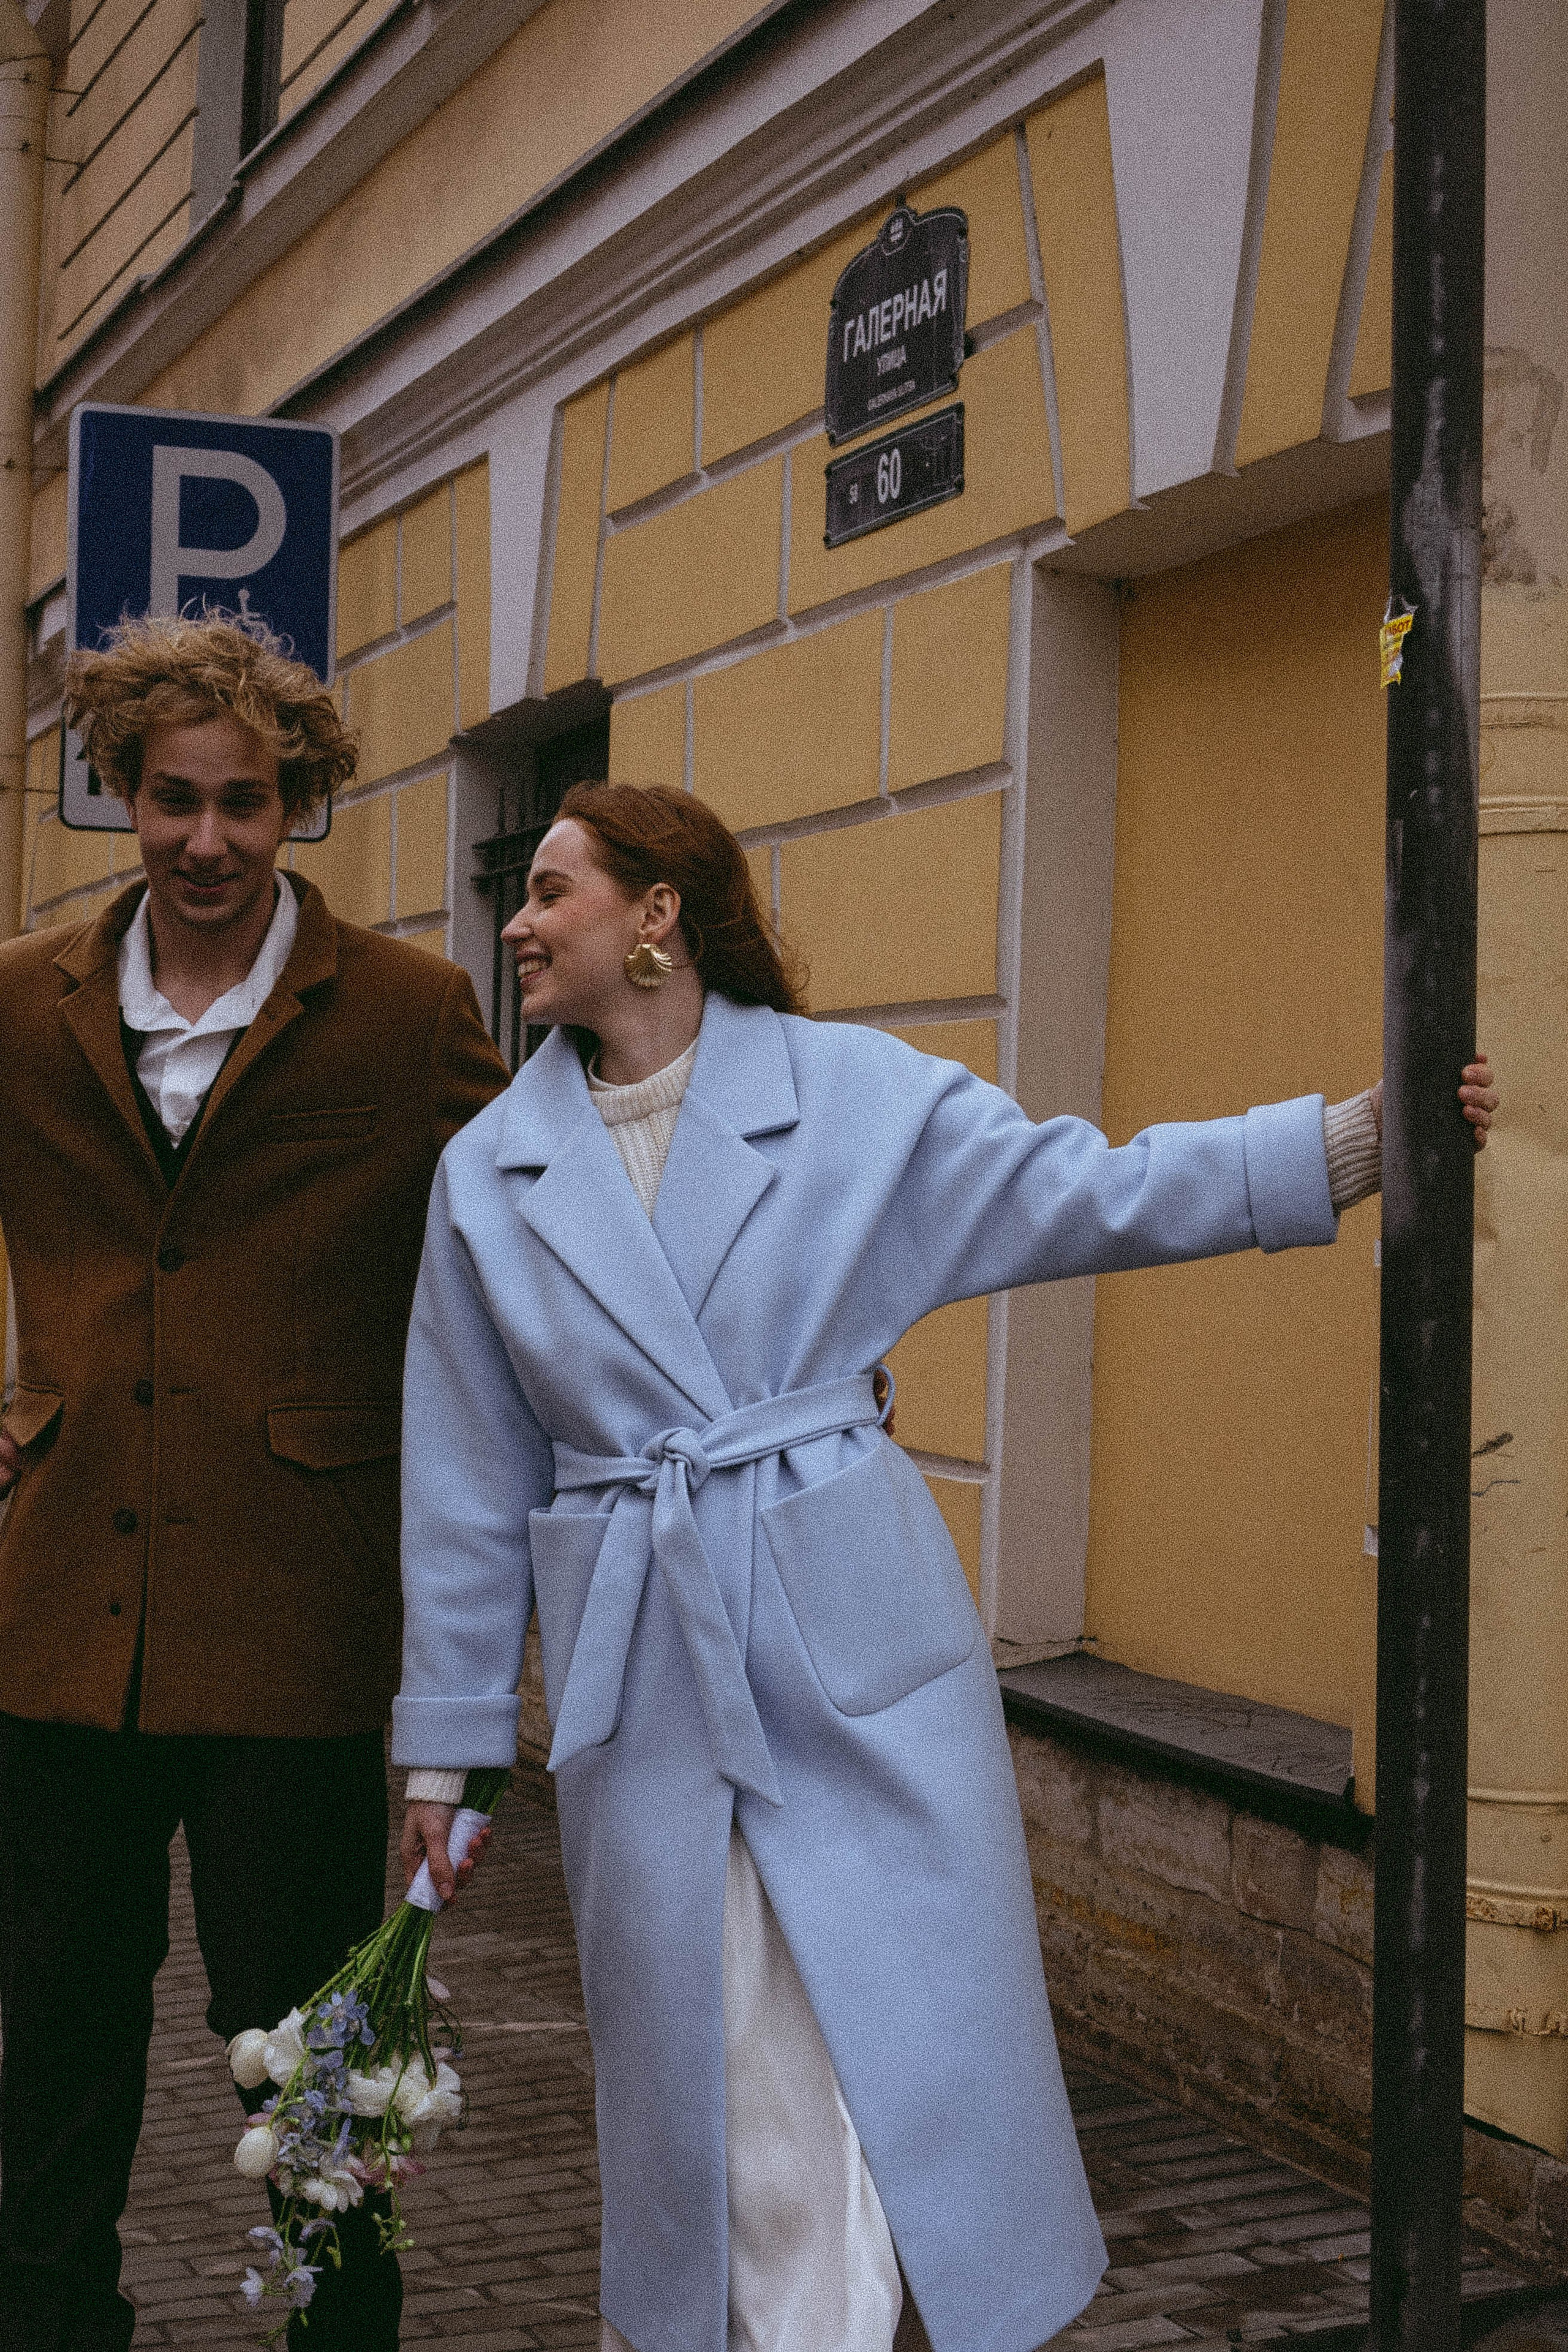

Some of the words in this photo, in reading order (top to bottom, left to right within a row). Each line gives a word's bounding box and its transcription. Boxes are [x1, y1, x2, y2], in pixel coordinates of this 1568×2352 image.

[843, 268, 948, 363] ГАЛЕРНАЯ
[877, 447, 902, 505] 60
[149, 445, 287, 620] P
